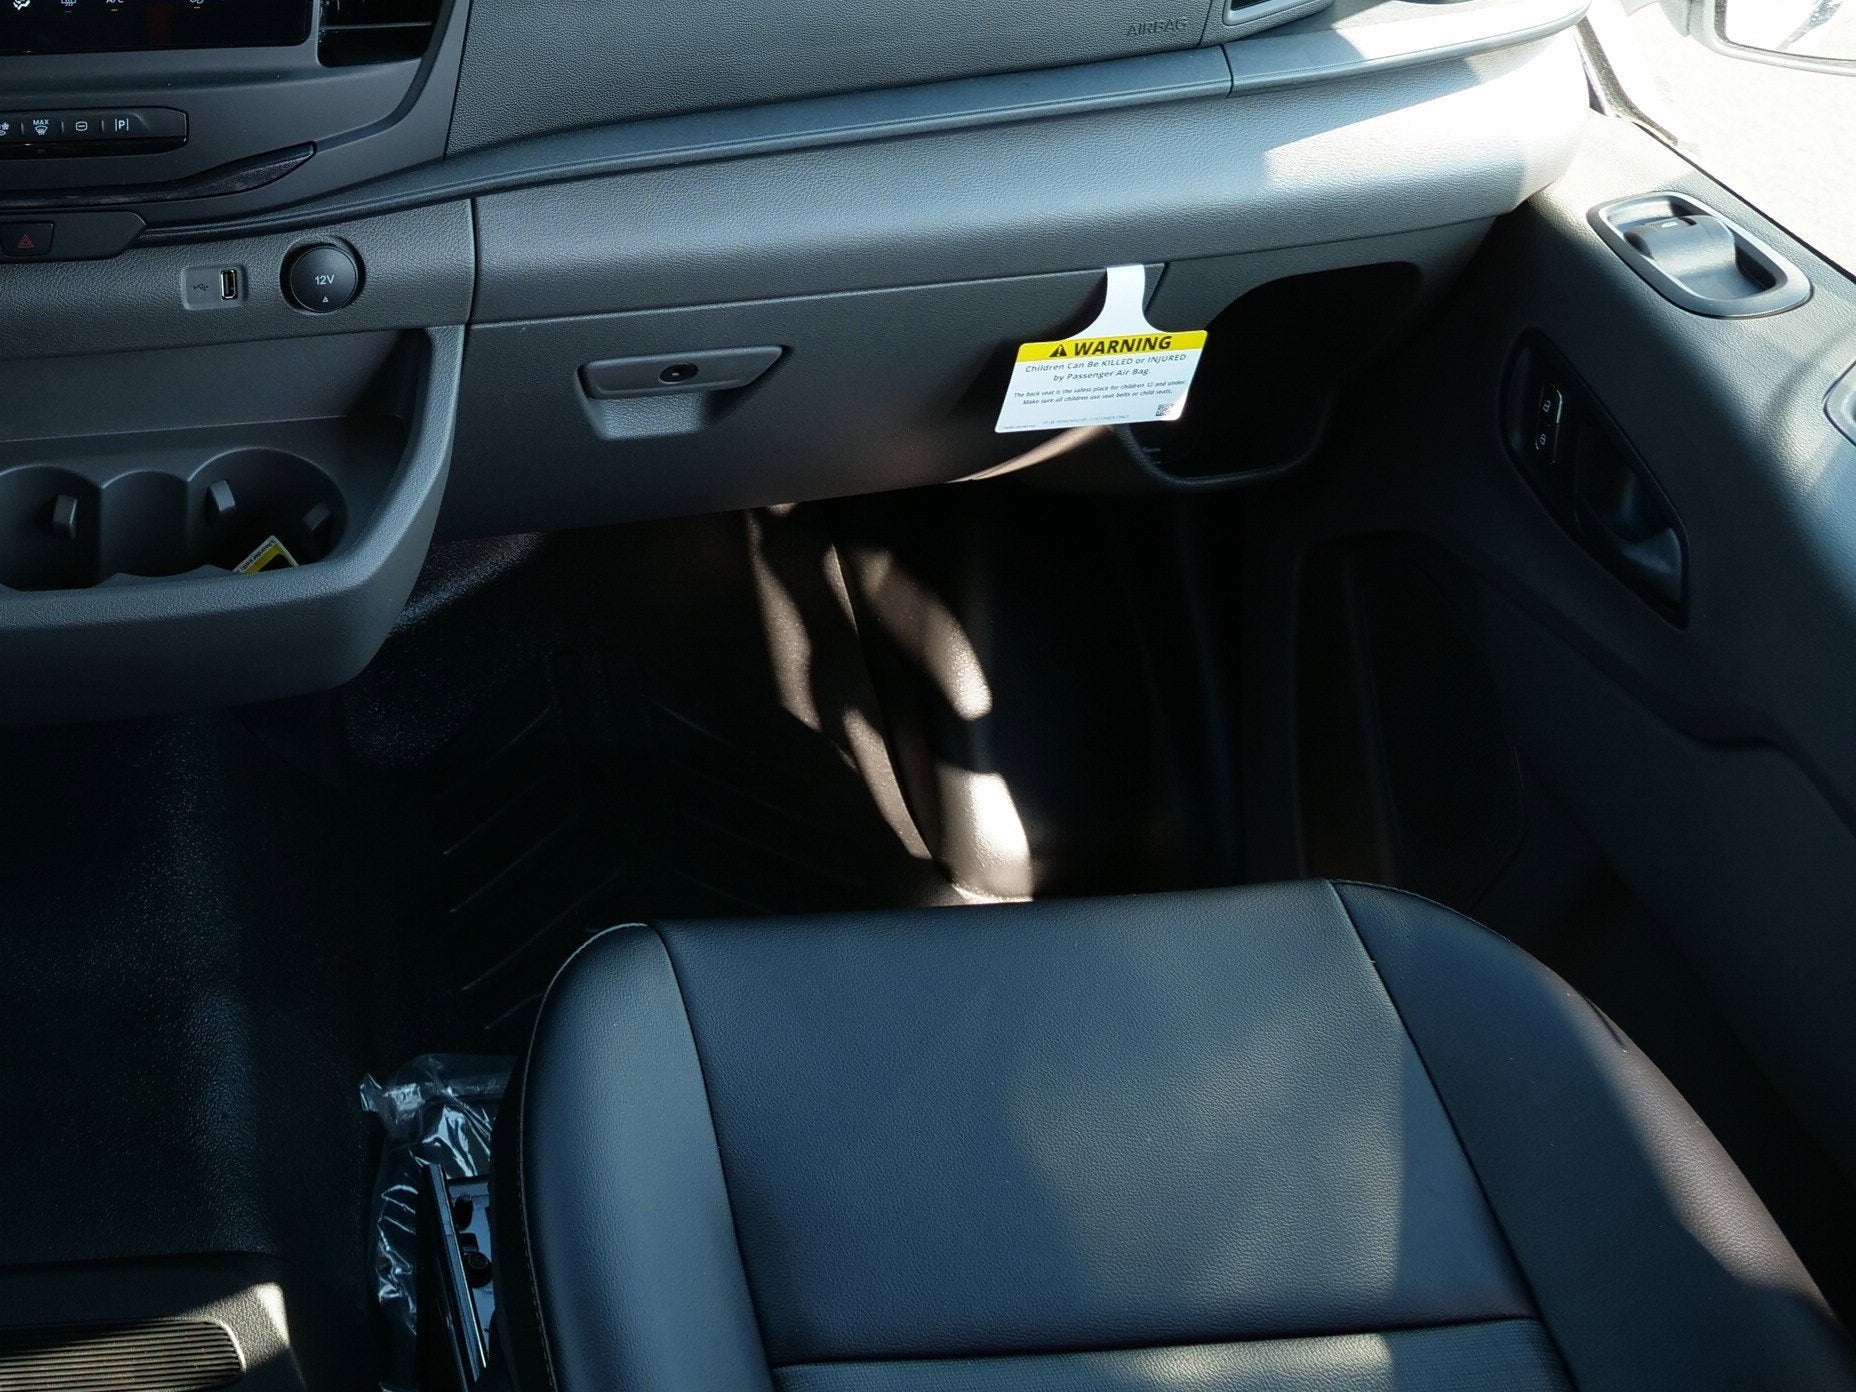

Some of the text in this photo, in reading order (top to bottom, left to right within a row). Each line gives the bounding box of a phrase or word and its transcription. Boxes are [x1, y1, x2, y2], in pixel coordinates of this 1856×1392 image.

[32, 119, 50, 127] MAX
[314, 273, 335, 286] 12V
[1074, 336, 1172, 356] WARNING
[1025, 364, 1064, 373] Children
[1067, 362, 1084, 370] Can
[1087, 360, 1099, 368] Be
[1101, 358, 1133, 366] KILLED
[1147, 353, 1187, 364] INJURED
[1053, 374, 1065, 382] by
[1067, 370, 1113, 380] Passenger
